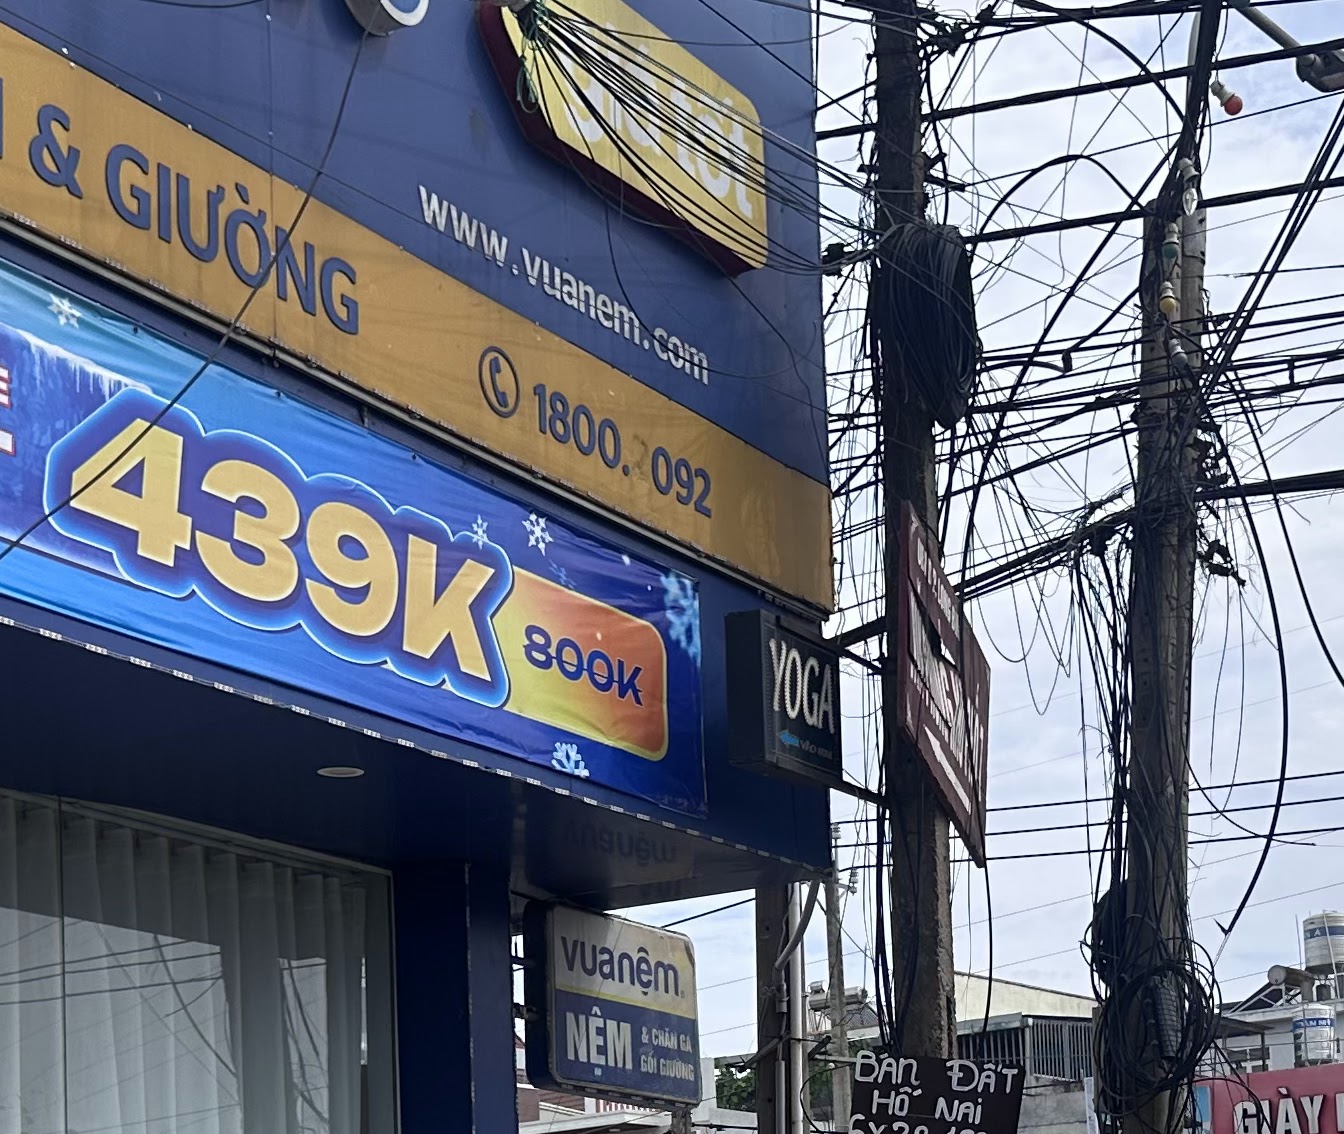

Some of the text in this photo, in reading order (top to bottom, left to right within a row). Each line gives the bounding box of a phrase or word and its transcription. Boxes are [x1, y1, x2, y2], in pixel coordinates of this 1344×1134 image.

[29, 103, 83, 200] &
[104, 142, 358, 337] GIƯỜNG
[69, 416, 496, 683] 439K
[522, 624, 645, 707] 800K
[768, 638, 835, 734] YOGA
[560, 936, 680, 997] vuanệm
[565, 1005, 693, 1077] NỆM & CHĂN GA
[640, 1049, 658, 1075] GỐI
[946, 1059, 1019, 1094] ĐẤT
